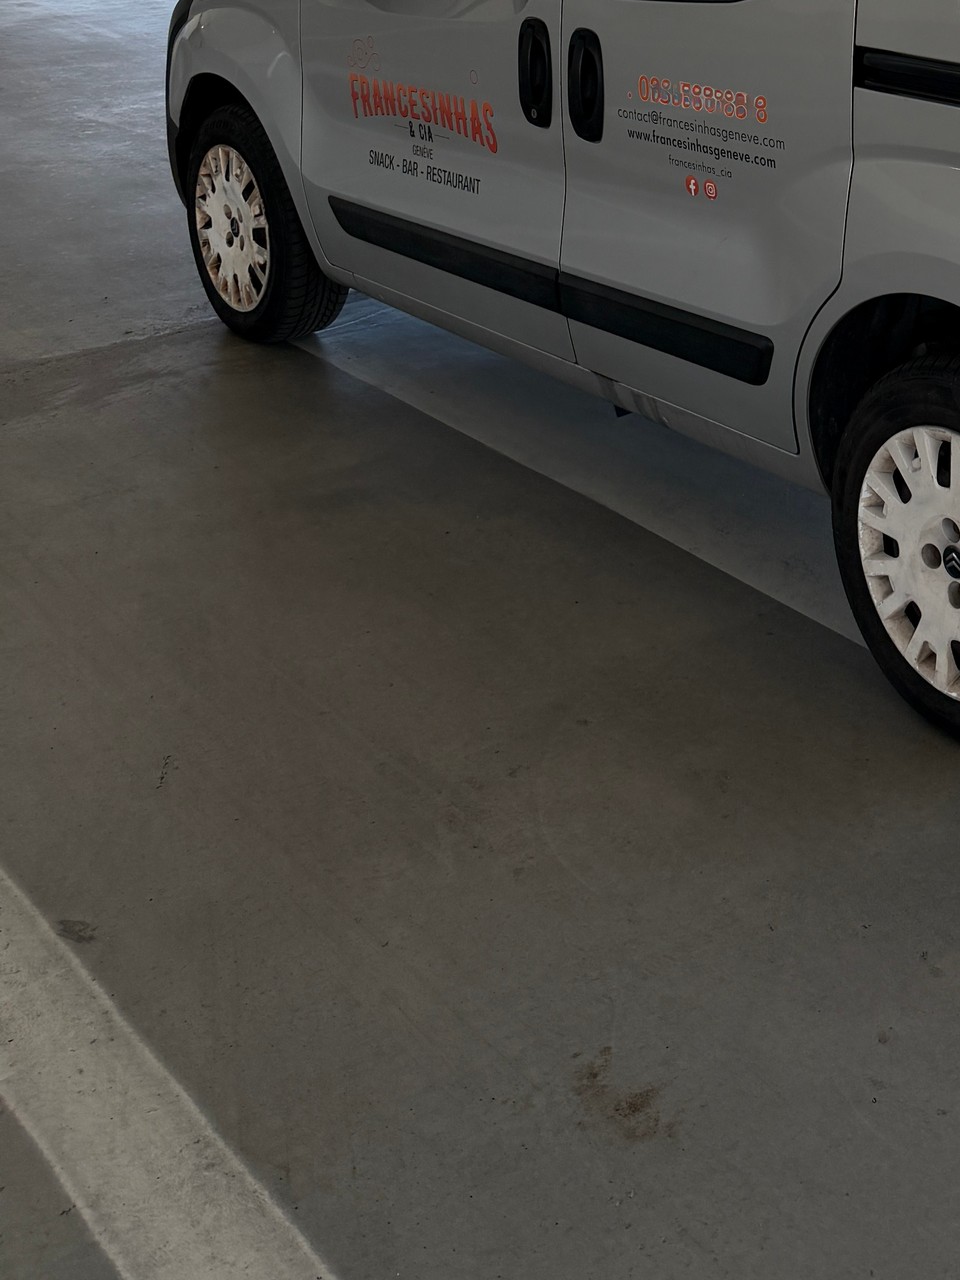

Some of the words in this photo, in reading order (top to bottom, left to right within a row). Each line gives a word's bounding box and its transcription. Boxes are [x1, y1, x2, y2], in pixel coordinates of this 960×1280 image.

[349, 73, 498, 154] FRANCESINHAS
[408, 120, 416, 138] &
[418, 123, 434, 143] CIA
[617, 107, 786, 151] contact@francesinhasgeneve.com
[627, 128, 777, 169] www.francesinhasgeneve.com
[668, 154, 733, 178] francesinhas_cia
[368, 149, 395, 171] SNACK
[402, 158, 418, 178] BAR
[426, 165, 481, 195] RESTAURANT
